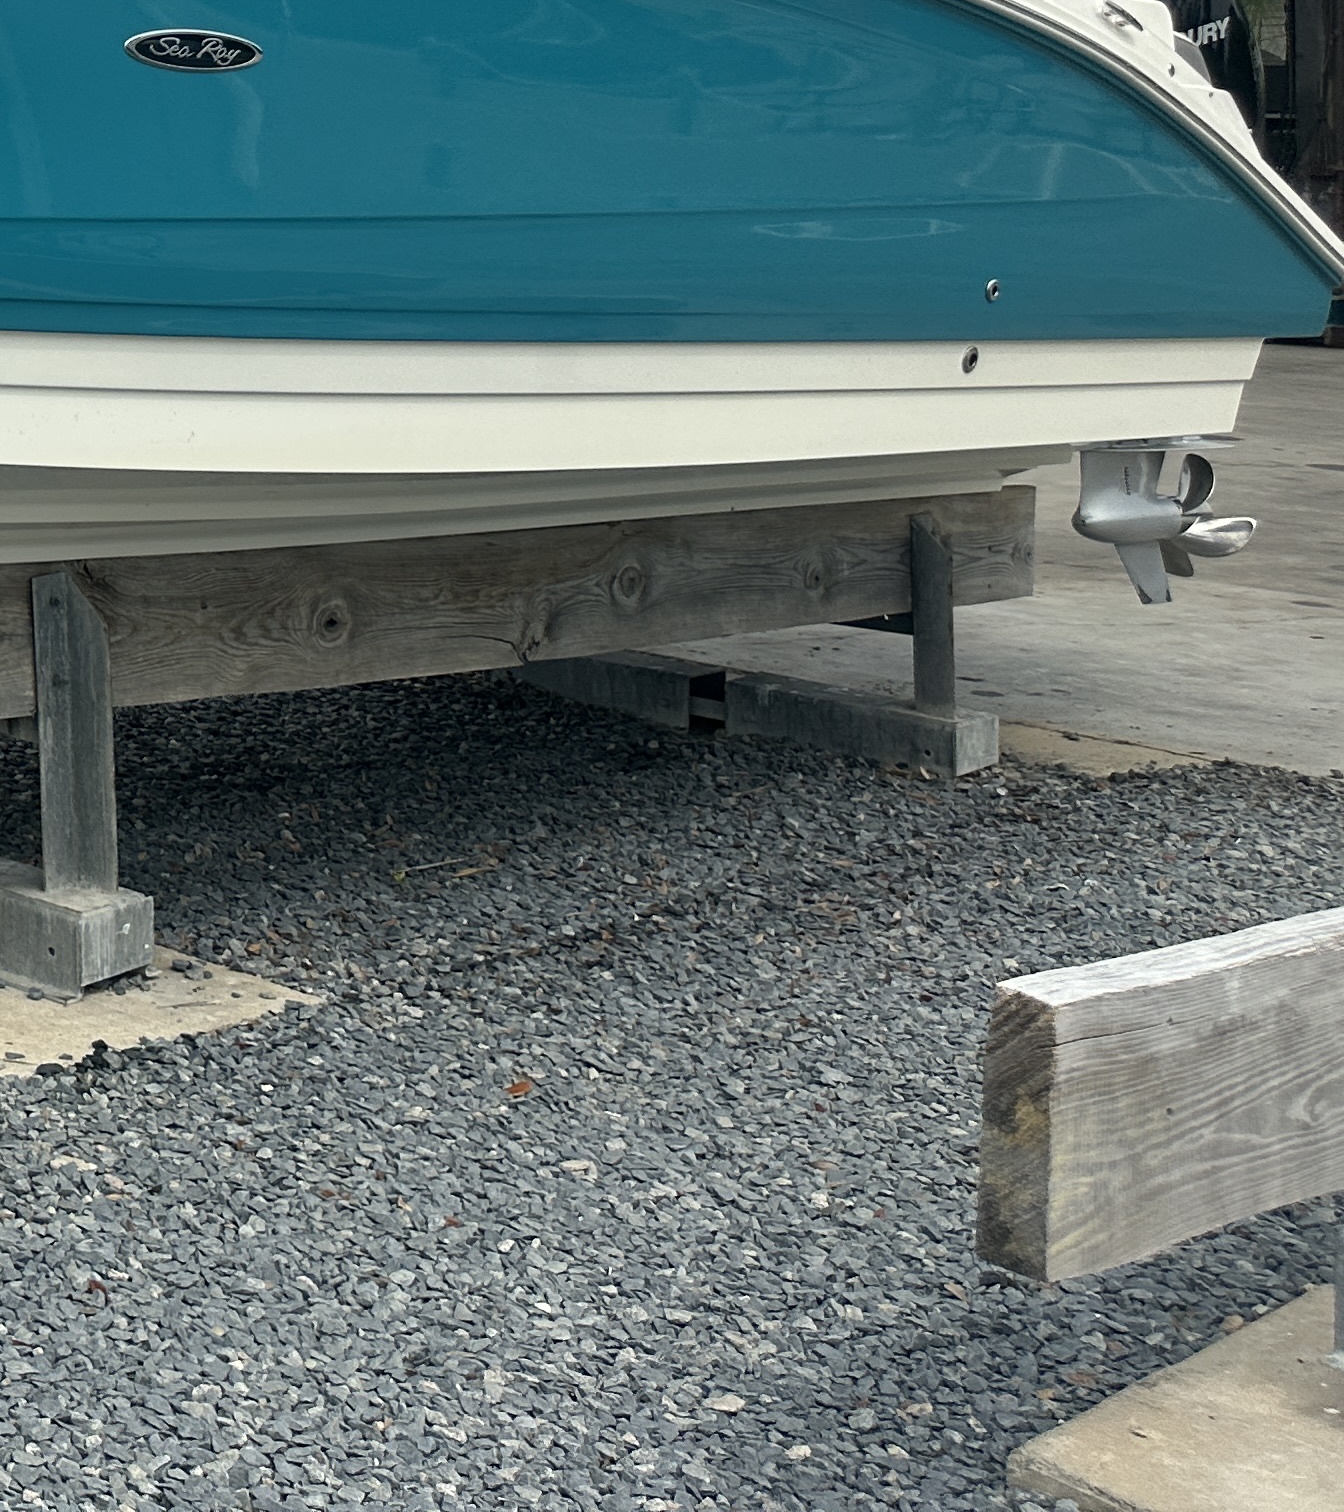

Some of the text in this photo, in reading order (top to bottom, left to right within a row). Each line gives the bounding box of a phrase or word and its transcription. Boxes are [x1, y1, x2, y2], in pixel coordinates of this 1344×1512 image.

[1186, 16, 1230, 46] URY
[149, 36, 242, 66] Sea Ray
